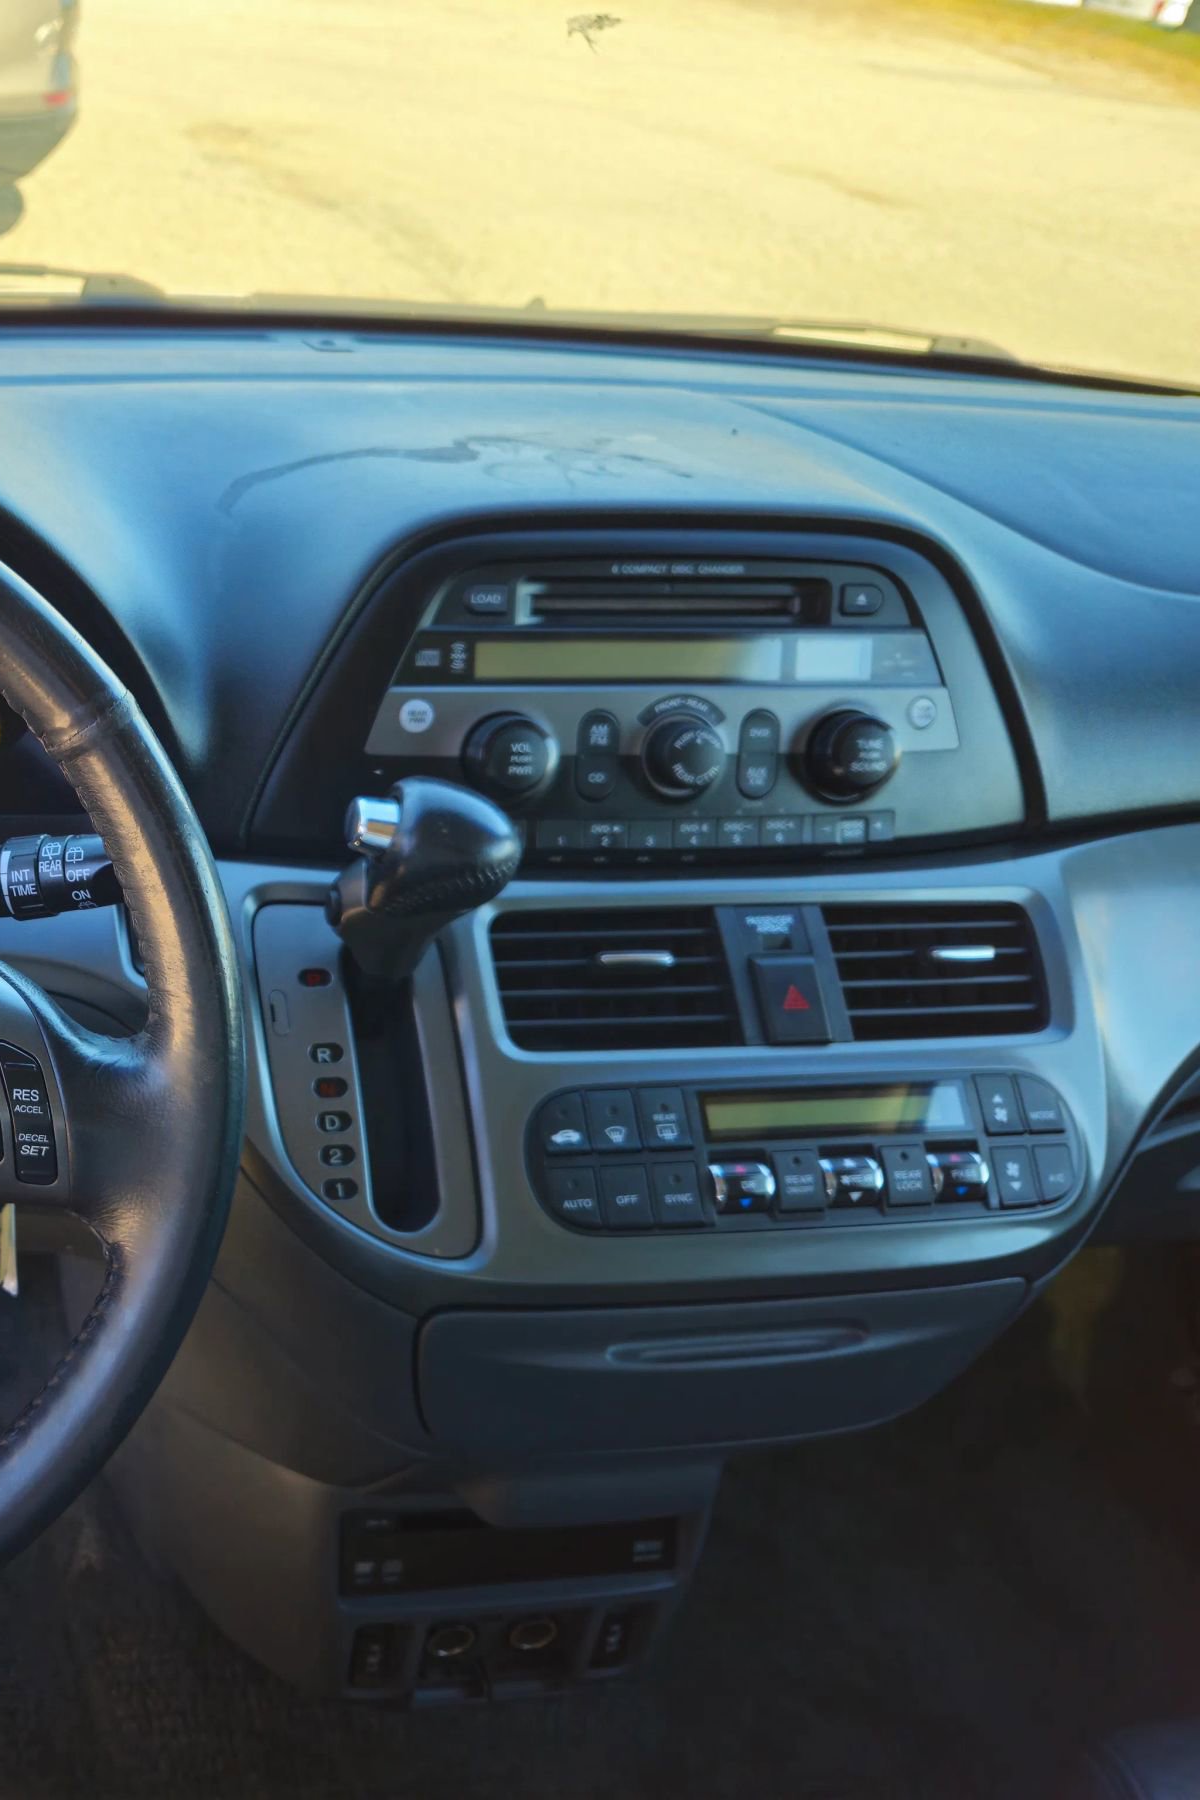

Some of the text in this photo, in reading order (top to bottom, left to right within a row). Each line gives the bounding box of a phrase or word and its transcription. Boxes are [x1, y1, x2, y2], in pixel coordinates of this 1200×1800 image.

[510, 743, 531, 753] VOL
[39, 860, 62, 873] REAR
[11, 869, 30, 882] INT
[66, 868, 91, 882] OFF
[9, 883, 37, 897] TIME
[72, 889, 91, 900] ON
[317, 1048, 330, 1063] R
[13, 1088, 39, 1102] RES
[14, 1105, 43, 1114] ACCEL
[325, 1116, 340, 1130] D
[18, 1133, 49, 1143] DECEL
[20, 1145, 49, 1156] SET
[330, 1148, 344, 1163] 2
[335, 1183, 344, 1197] 1
[563, 1199, 592, 1209] AUTO
[615, 1195, 638, 1206] OFF
